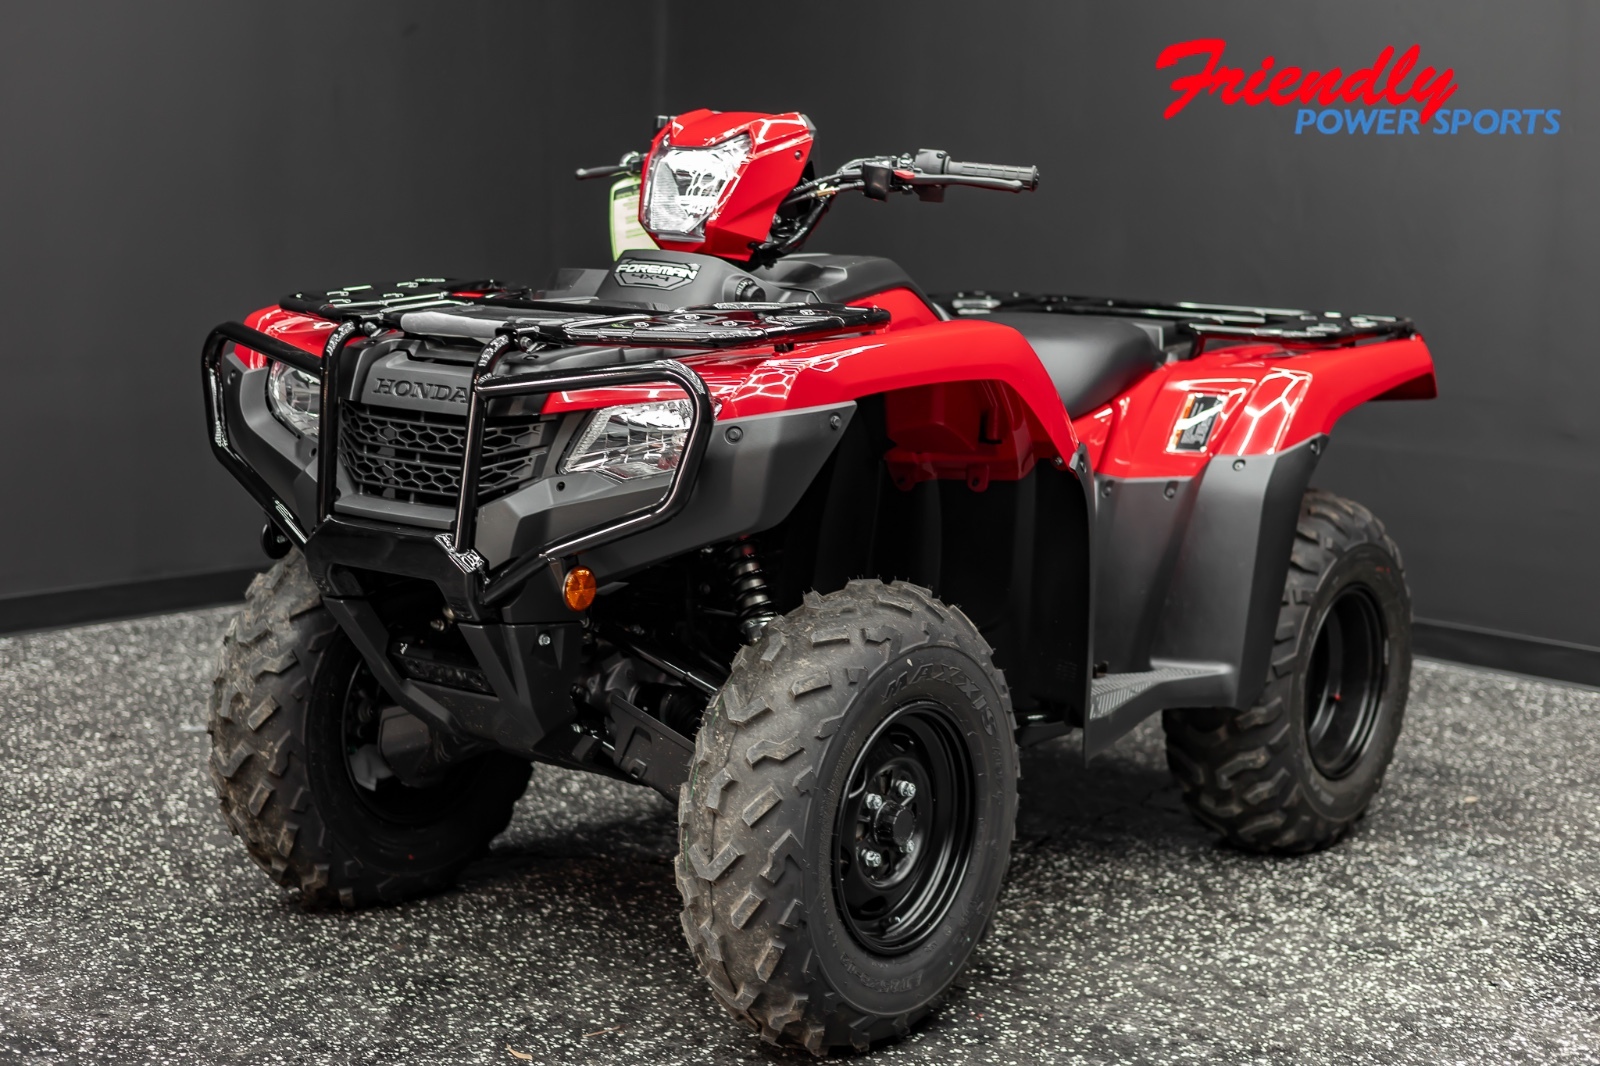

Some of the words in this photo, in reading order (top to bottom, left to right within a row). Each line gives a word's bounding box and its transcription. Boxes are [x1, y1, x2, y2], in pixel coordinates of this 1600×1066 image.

[616, 264, 698, 280] FOREMAN
[373, 378, 469, 404] HONDA
[881, 662, 998, 736] MAXXIS
